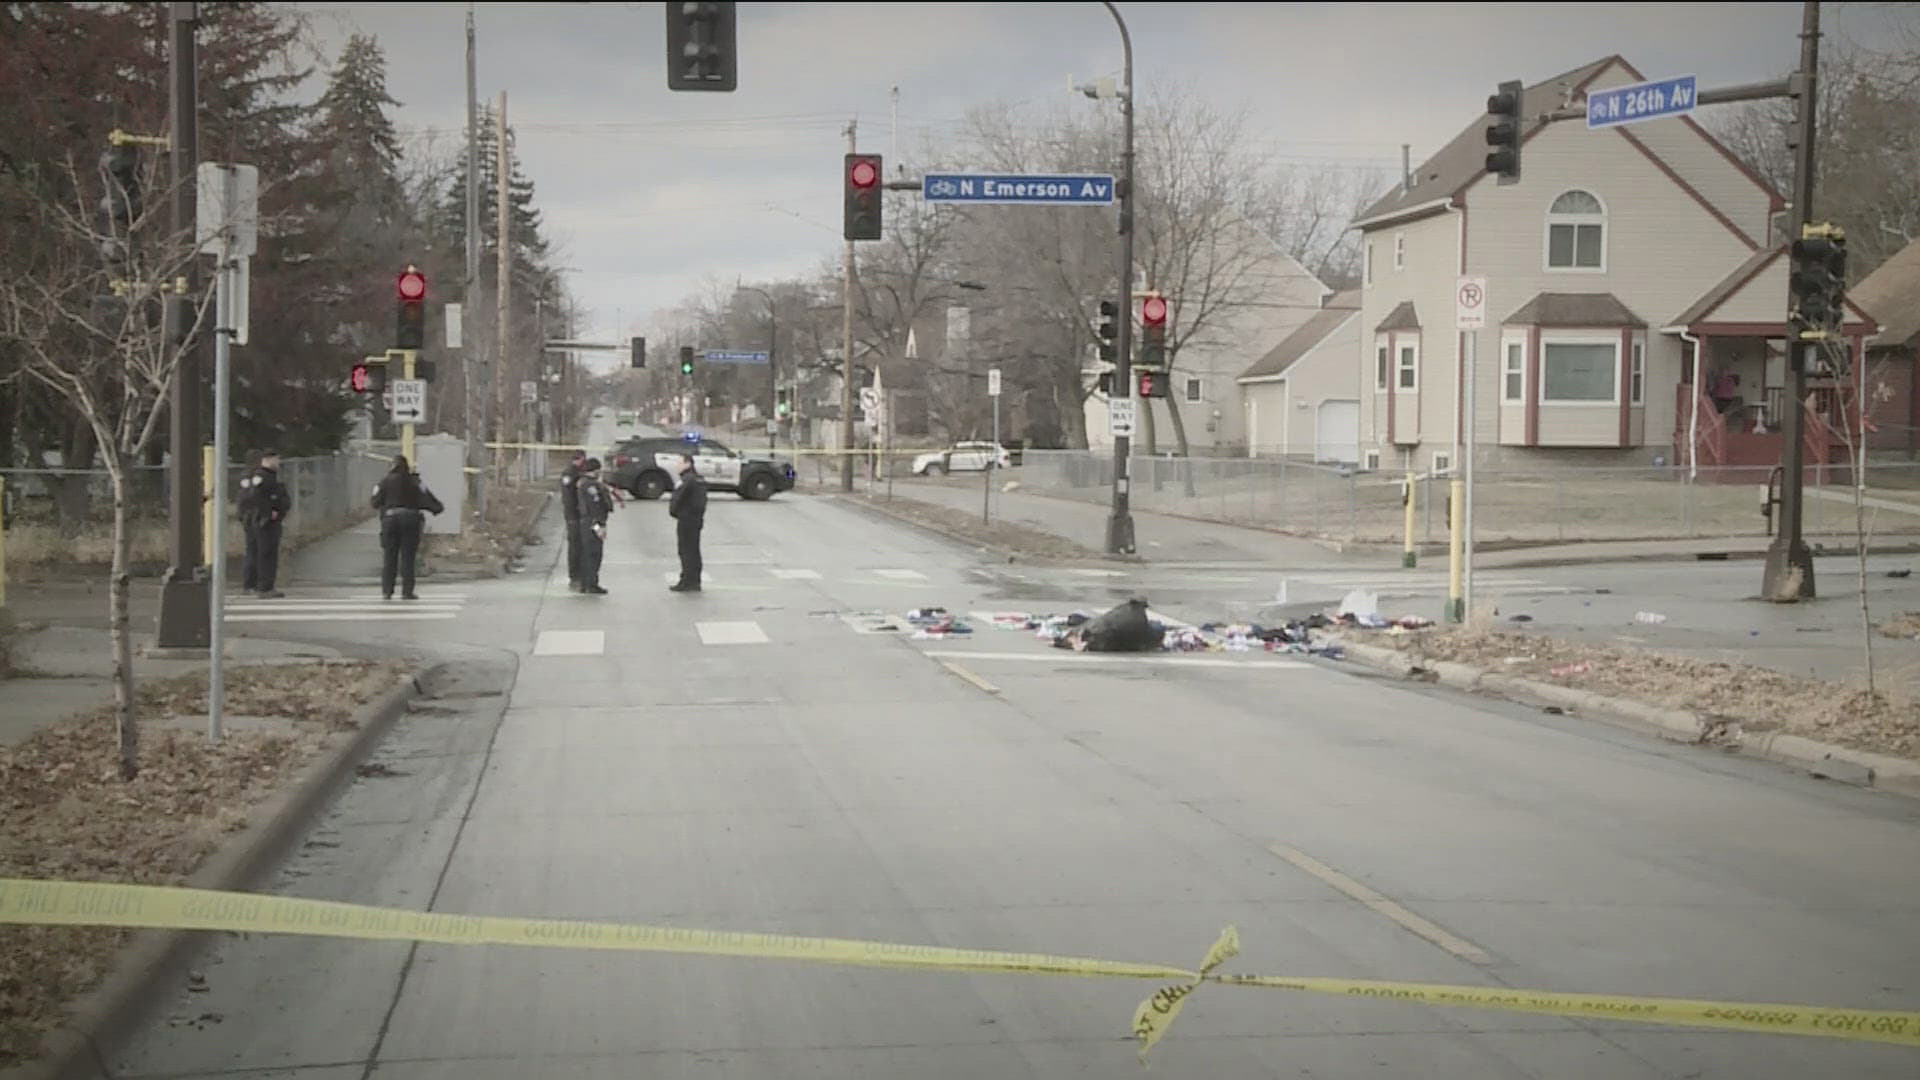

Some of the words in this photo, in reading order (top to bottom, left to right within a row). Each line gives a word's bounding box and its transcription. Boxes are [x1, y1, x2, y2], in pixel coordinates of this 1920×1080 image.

[1608, 95, 1620, 118] N
[1625, 87, 1665, 116] 26th
[1670, 84, 1692, 107] Av
[960, 180, 974, 196] N
[983, 180, 1070, 197] Emerson
[1080, 181, 1107, 197] Av
[396, 382, 421, 394] ONE
[396, 395, 421, 406] WAY
[1112, 400, 1134, 410] ONE
